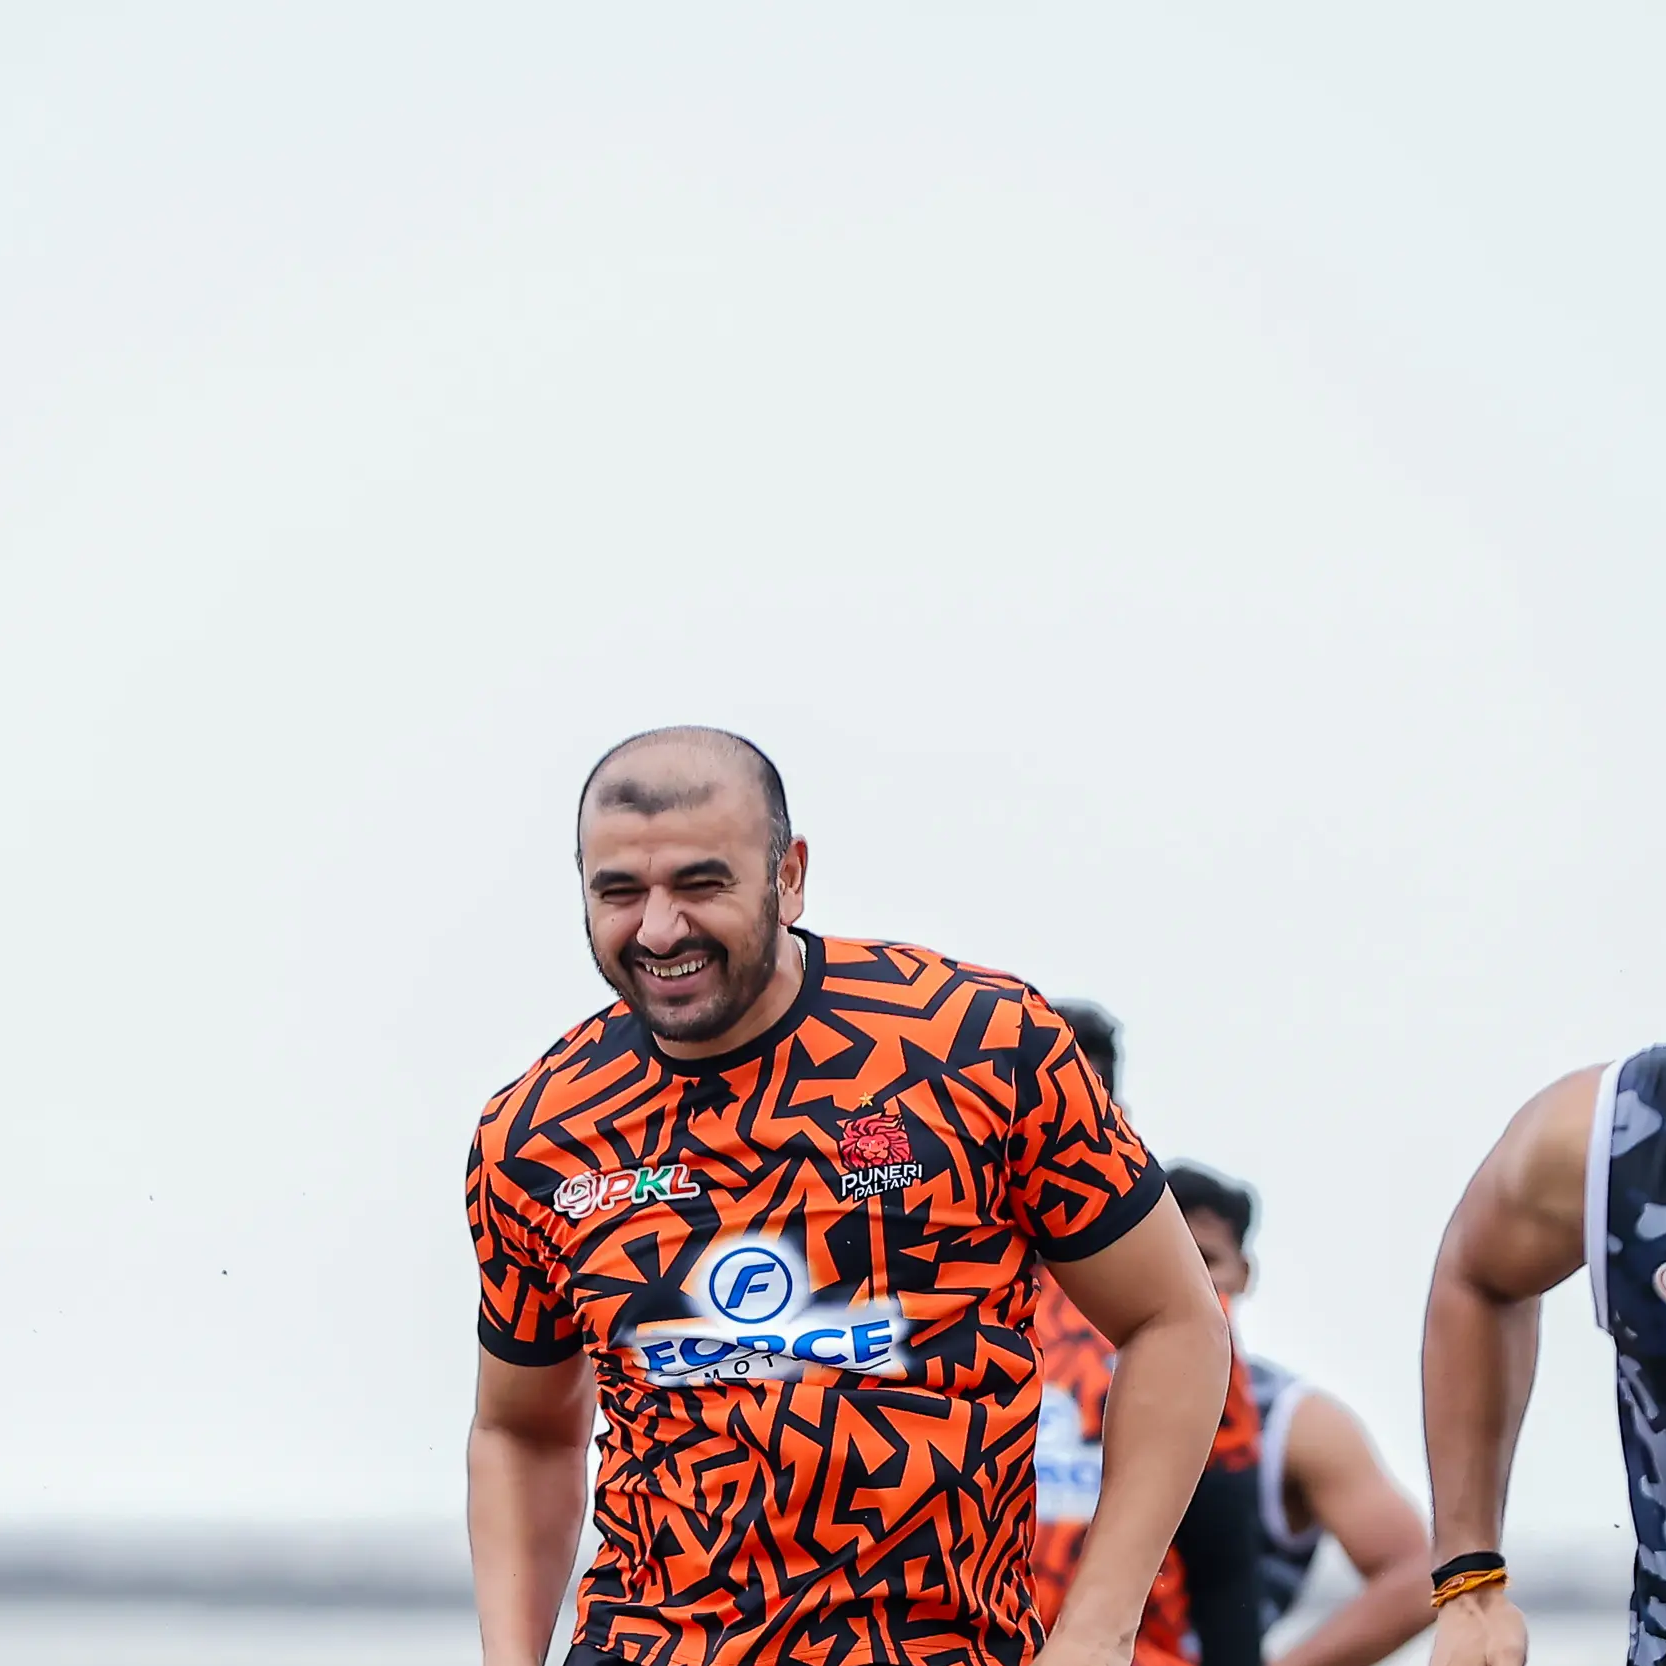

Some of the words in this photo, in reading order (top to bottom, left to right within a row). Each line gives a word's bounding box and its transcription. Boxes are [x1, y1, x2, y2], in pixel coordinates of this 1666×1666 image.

[601, 1165, 699, 1208] PKL
[841, 1163, 923, 1197] PUNERI
[854, 1176, 911, 1201] PALTAN
